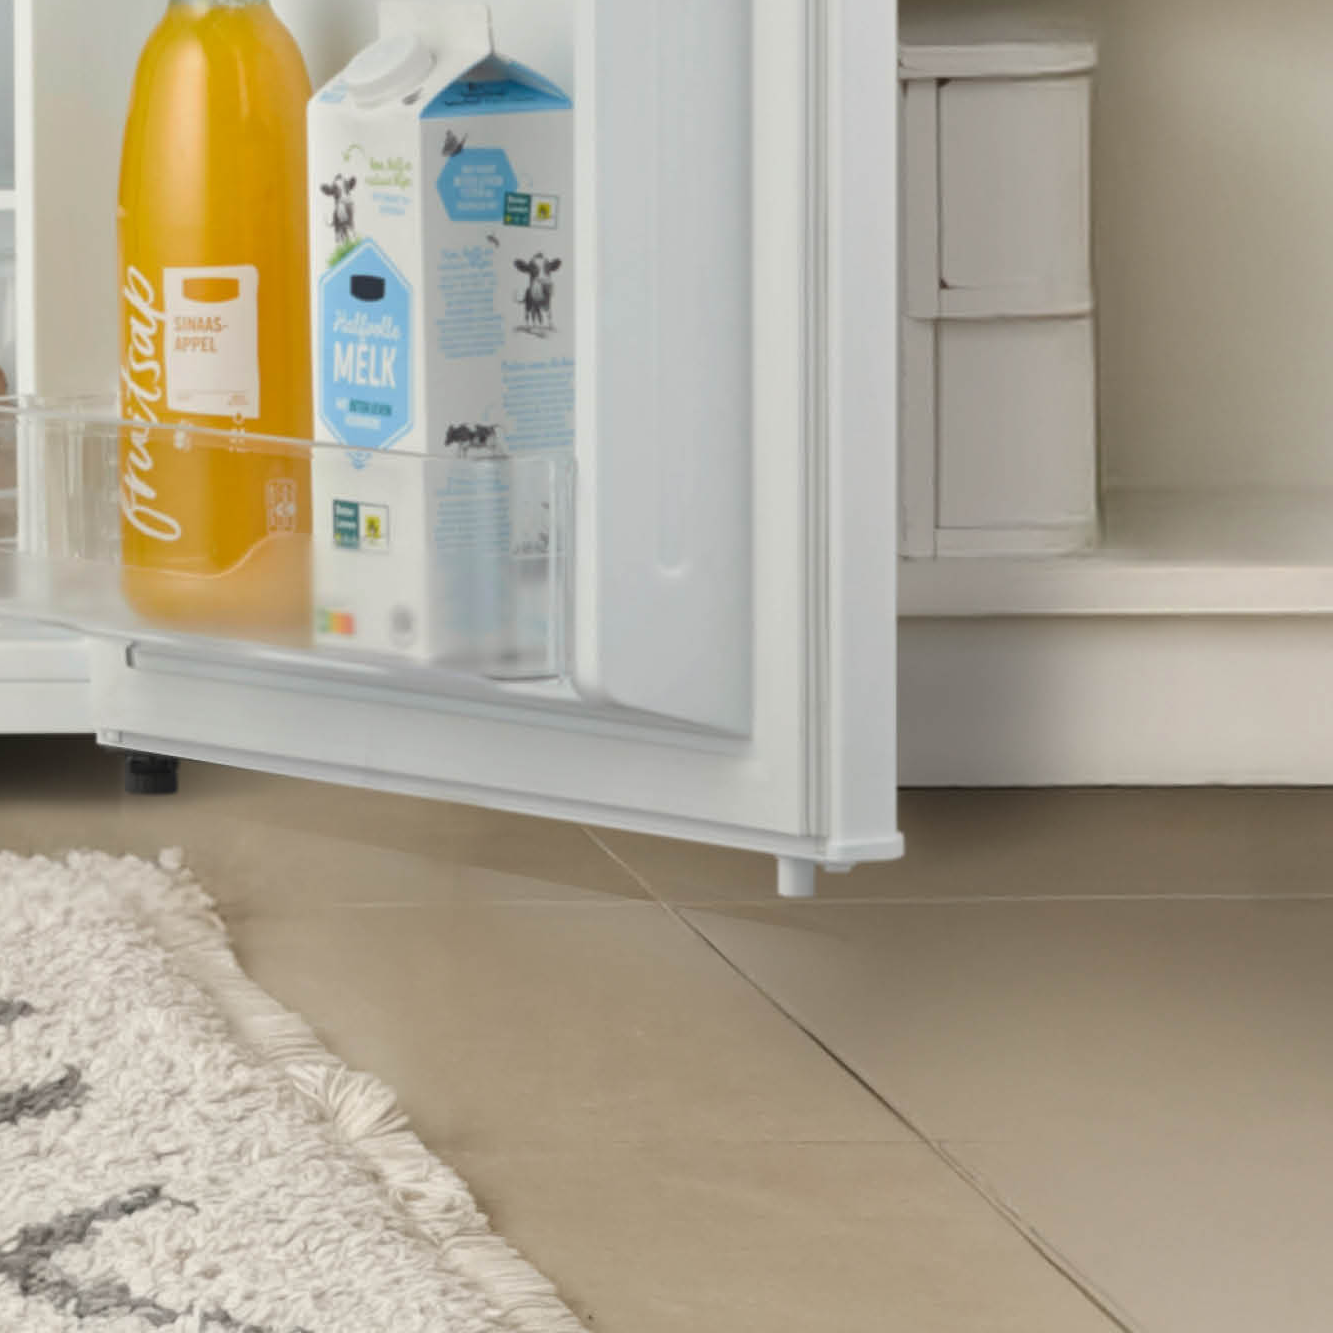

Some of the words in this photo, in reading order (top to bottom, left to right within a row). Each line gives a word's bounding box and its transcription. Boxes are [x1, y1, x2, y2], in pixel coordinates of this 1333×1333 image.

[173, 335, 218, 352] APPEL
[333, 340, 397, 389] MELK
[121, 265, 181, 541] fruitsap
